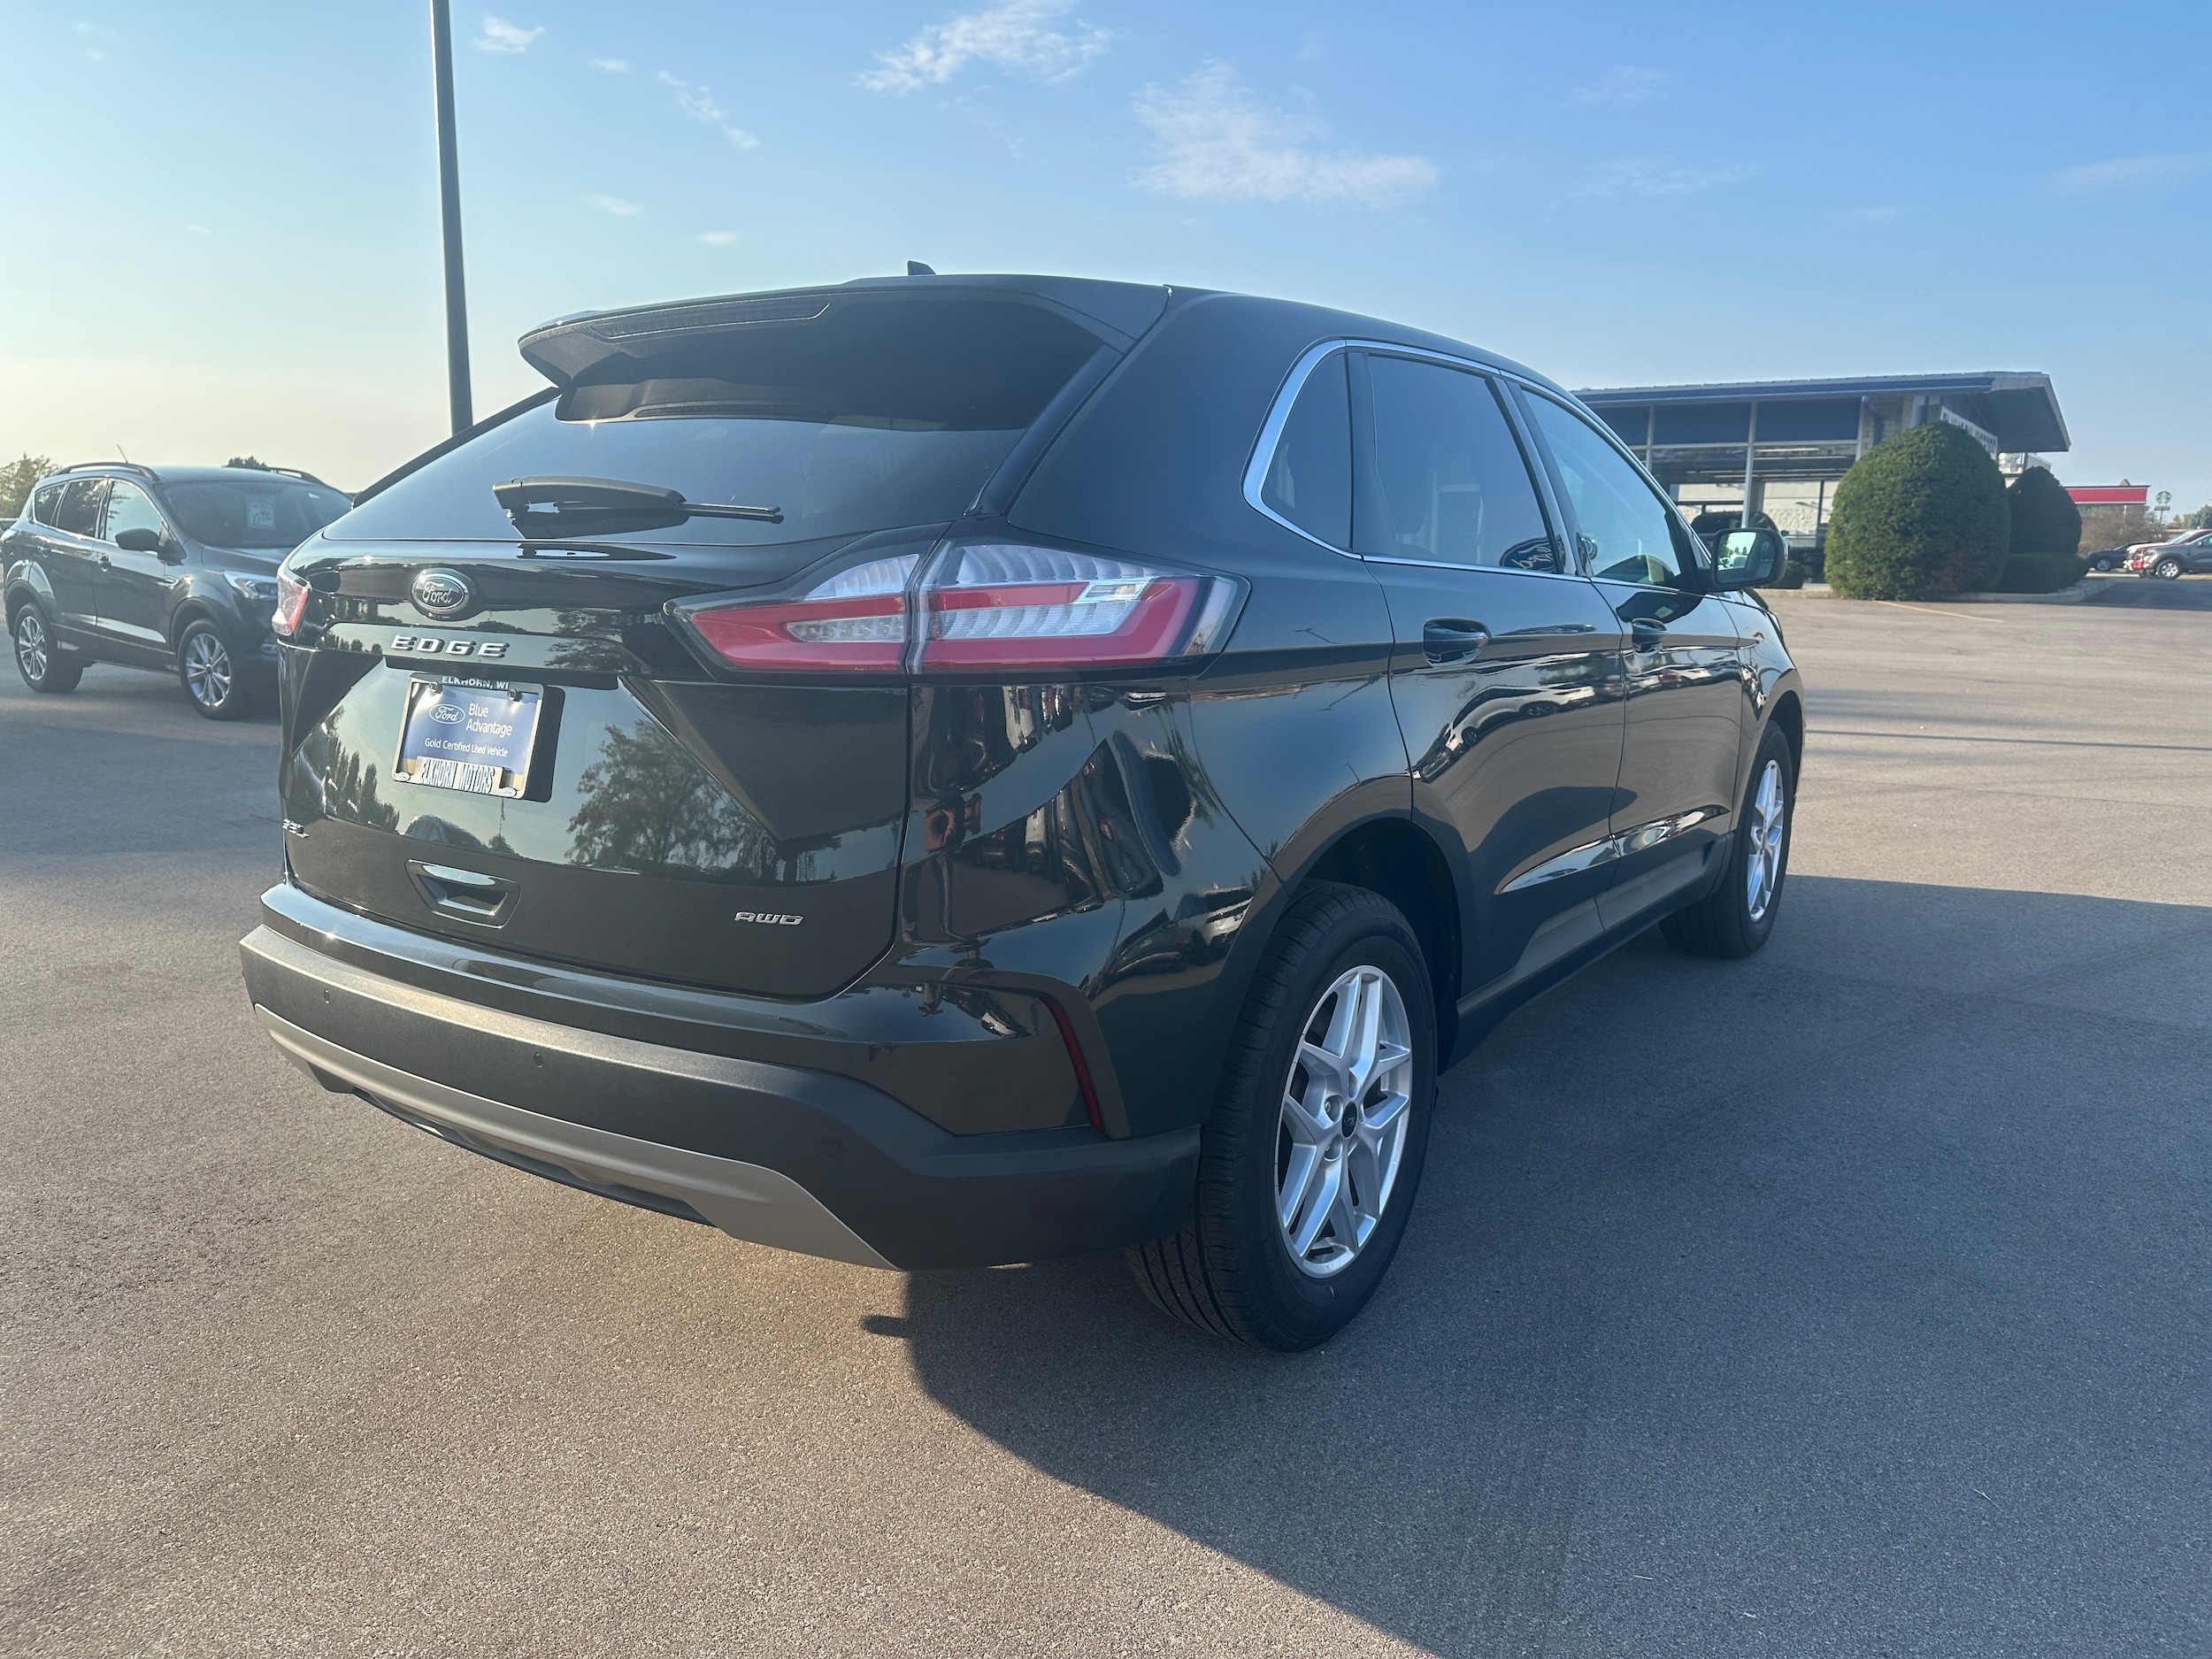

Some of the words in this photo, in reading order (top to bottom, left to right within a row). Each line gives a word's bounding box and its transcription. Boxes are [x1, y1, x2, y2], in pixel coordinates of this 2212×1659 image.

[422, 581, 452, 603] Ford
[390, 634, 511, 657] EDGE
[496, 680, 510, 689] WI
[434, 706, 459, 721] Ford
[469, 703, 488, 718] Blue
[465, 718, 512, 737] Advantage
[425, 738, 442, 749] Gold
[442, 741, 470, 753] Certified
[471, 744, 486, 755] Used
[487, 745, 509, 757] Vehicle
[421, 758, 457, 787] ELKHORN
[458, 763, 495, 795] MOTORS
[733, 911, 803, 926] AWD
